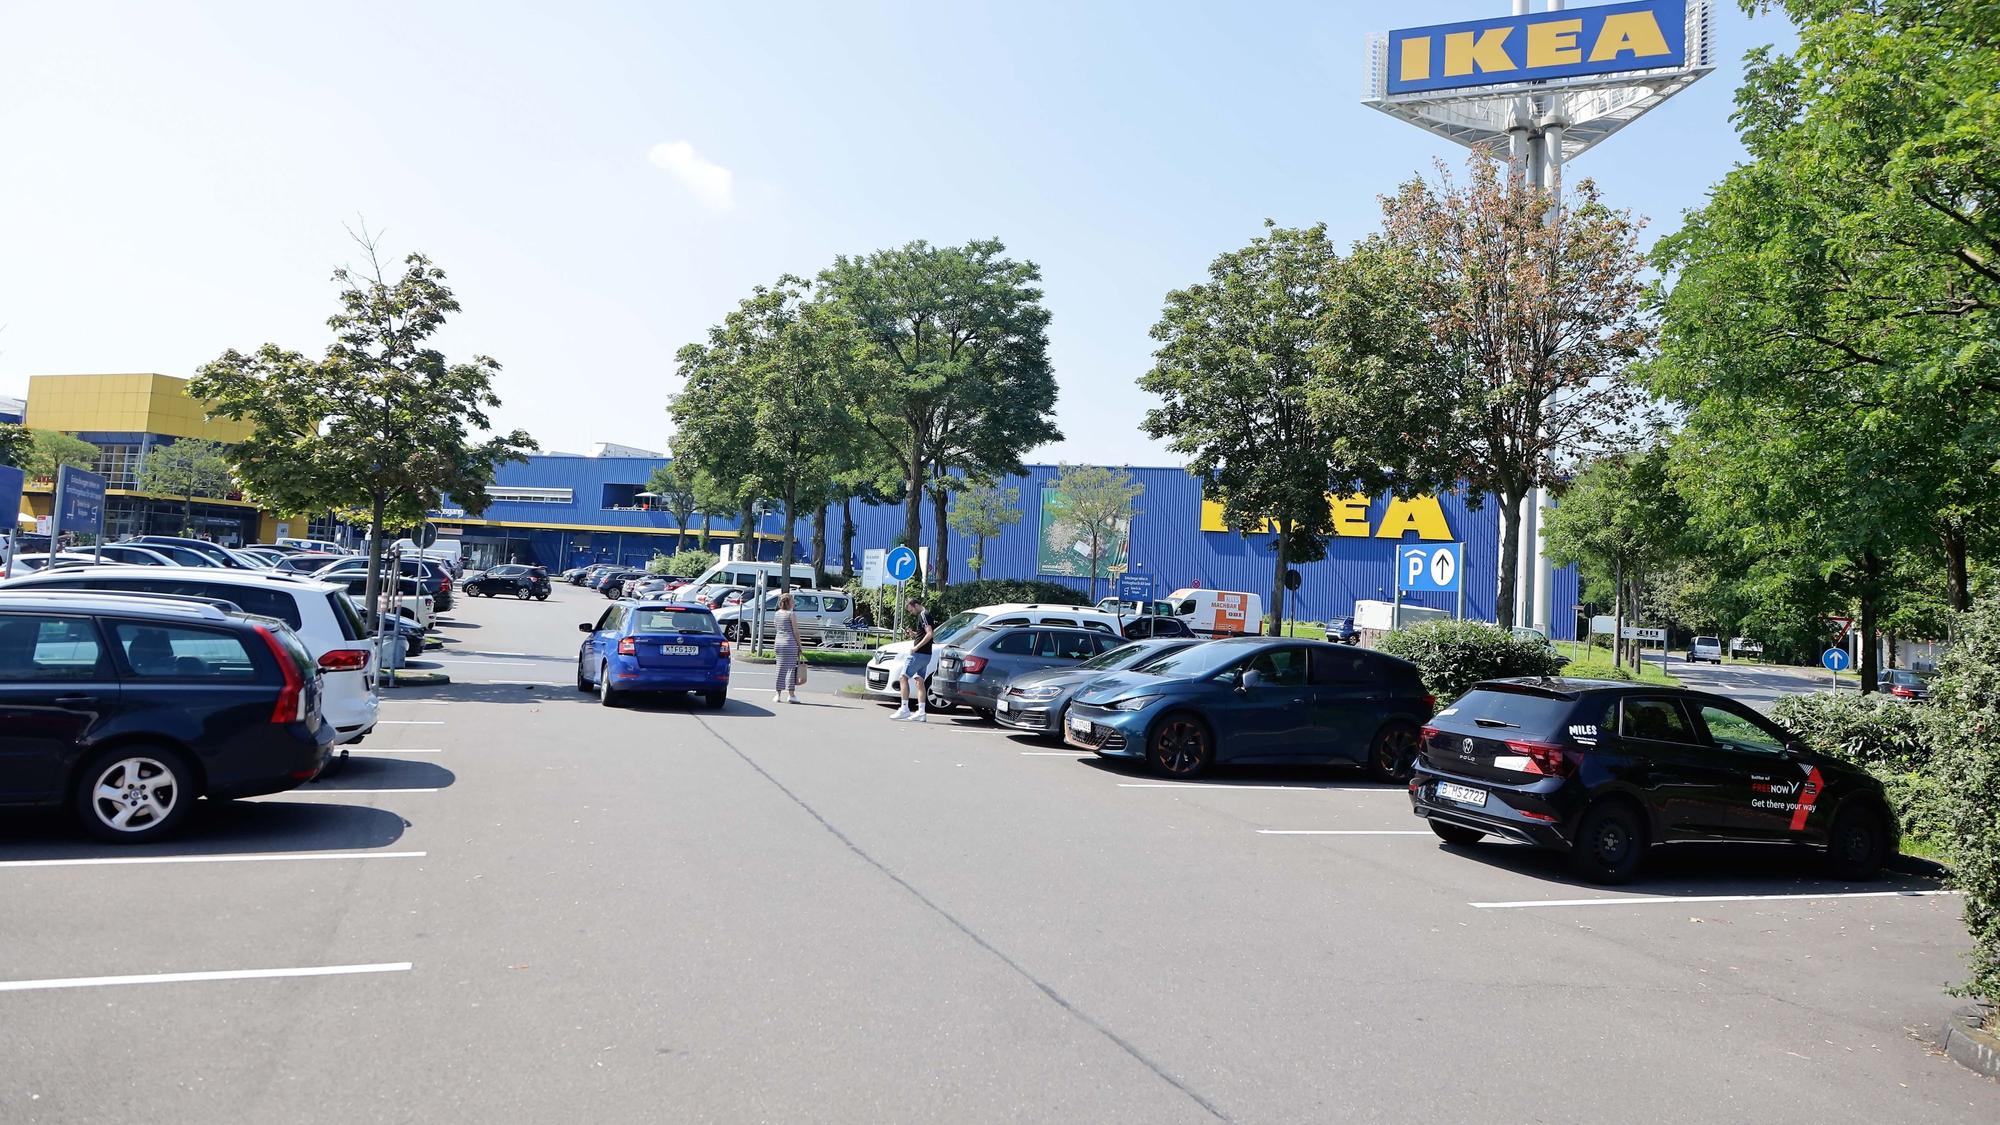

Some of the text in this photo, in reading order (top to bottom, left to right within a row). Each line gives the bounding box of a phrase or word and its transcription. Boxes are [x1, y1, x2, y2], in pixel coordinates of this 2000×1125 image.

[1400, 10, 1671, 81] IKEA
[1200, 490, 1454, 540] IEA
[1408, 557, 1423, 585] P
[1569, 724, 1598, 736] MILES
[1463, 788, 1485, 803] 2722
[1751, 798, 1817, 813] Get there your way
